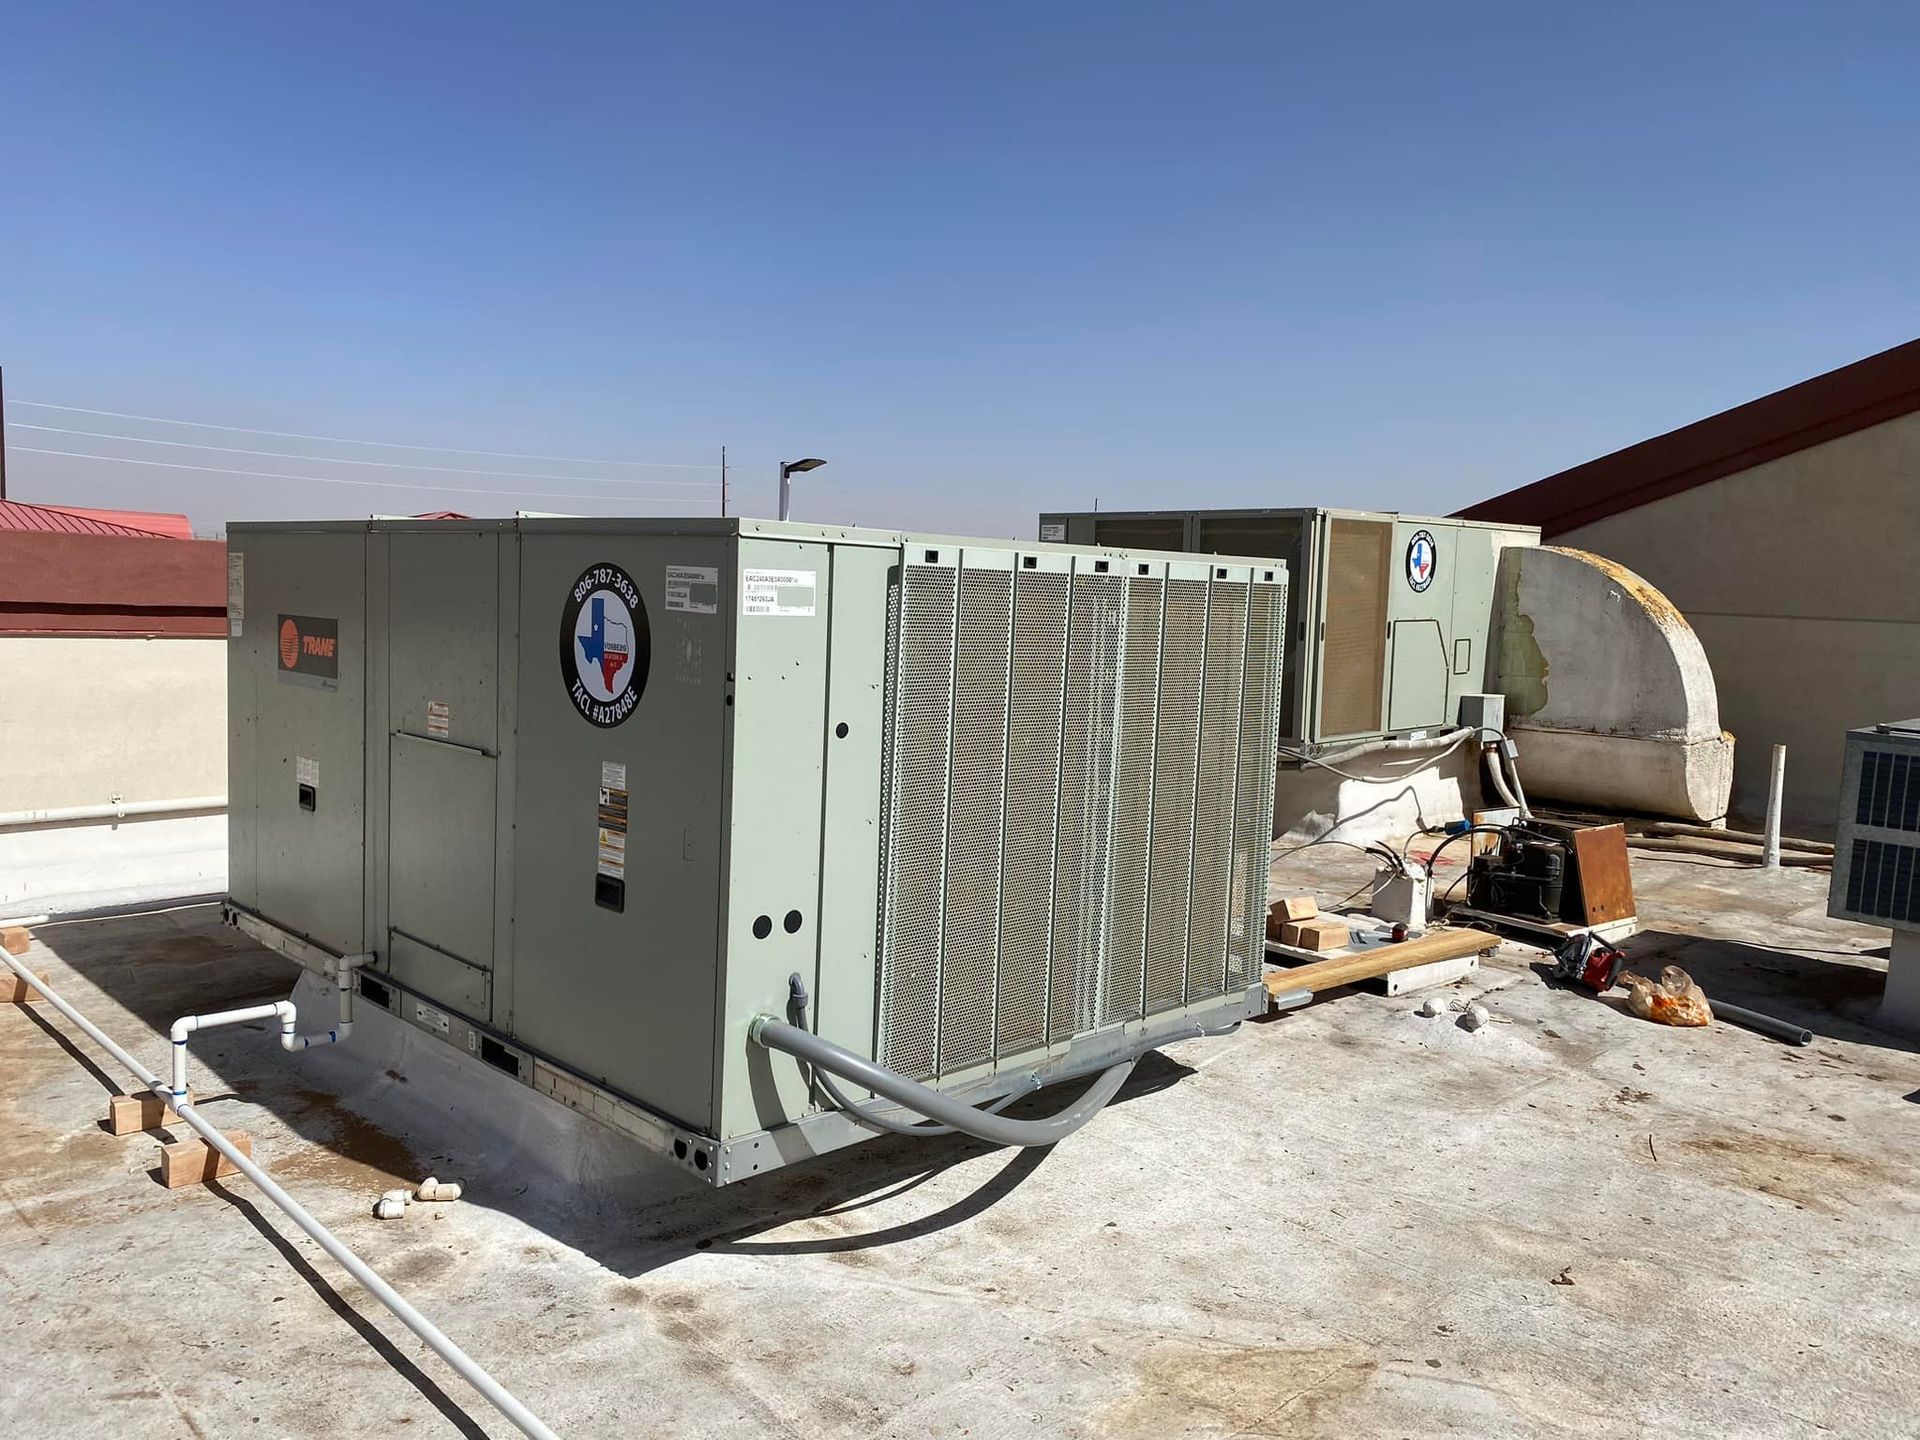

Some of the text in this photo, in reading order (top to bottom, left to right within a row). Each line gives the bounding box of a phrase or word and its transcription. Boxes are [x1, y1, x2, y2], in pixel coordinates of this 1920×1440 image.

[574, 568, 639, 609] 806-787-3638
[303, 635, 335, 657] TRANE
[571, 678, 638, 724] TACL #A27848E
